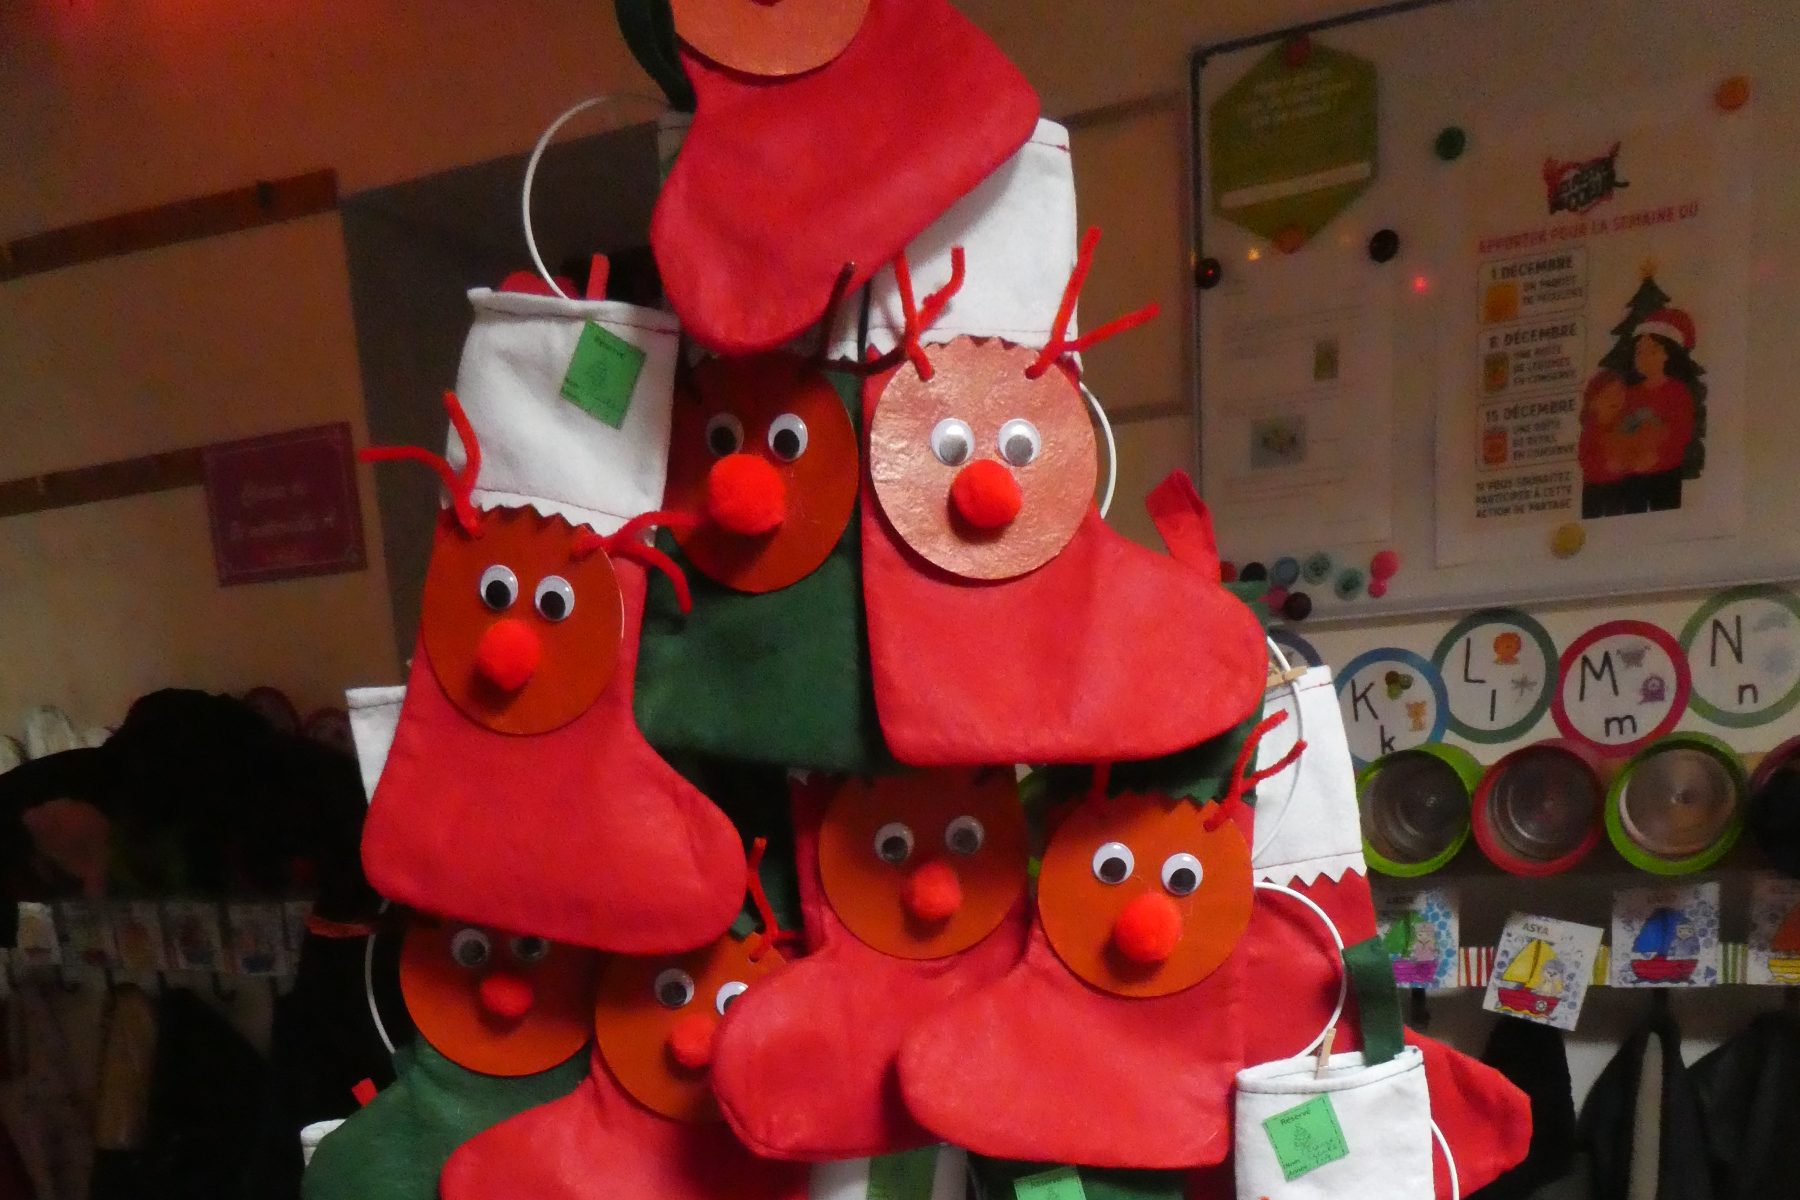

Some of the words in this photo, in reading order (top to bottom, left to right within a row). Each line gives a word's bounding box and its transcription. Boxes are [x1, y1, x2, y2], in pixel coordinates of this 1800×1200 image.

[1503, 398, 1576, 420] DÉCEMBRE
[1711, 614, 1745, 667] N
[1463, 637, 1488, 684] L
[1580, 650, 1620, 702] M
[1351, 678, 1379, 722] K
[1738, 682, 1759, 705] n
[1605, 712, 1637, 738] m
[1522, 922, 1550, 936] ASYA
